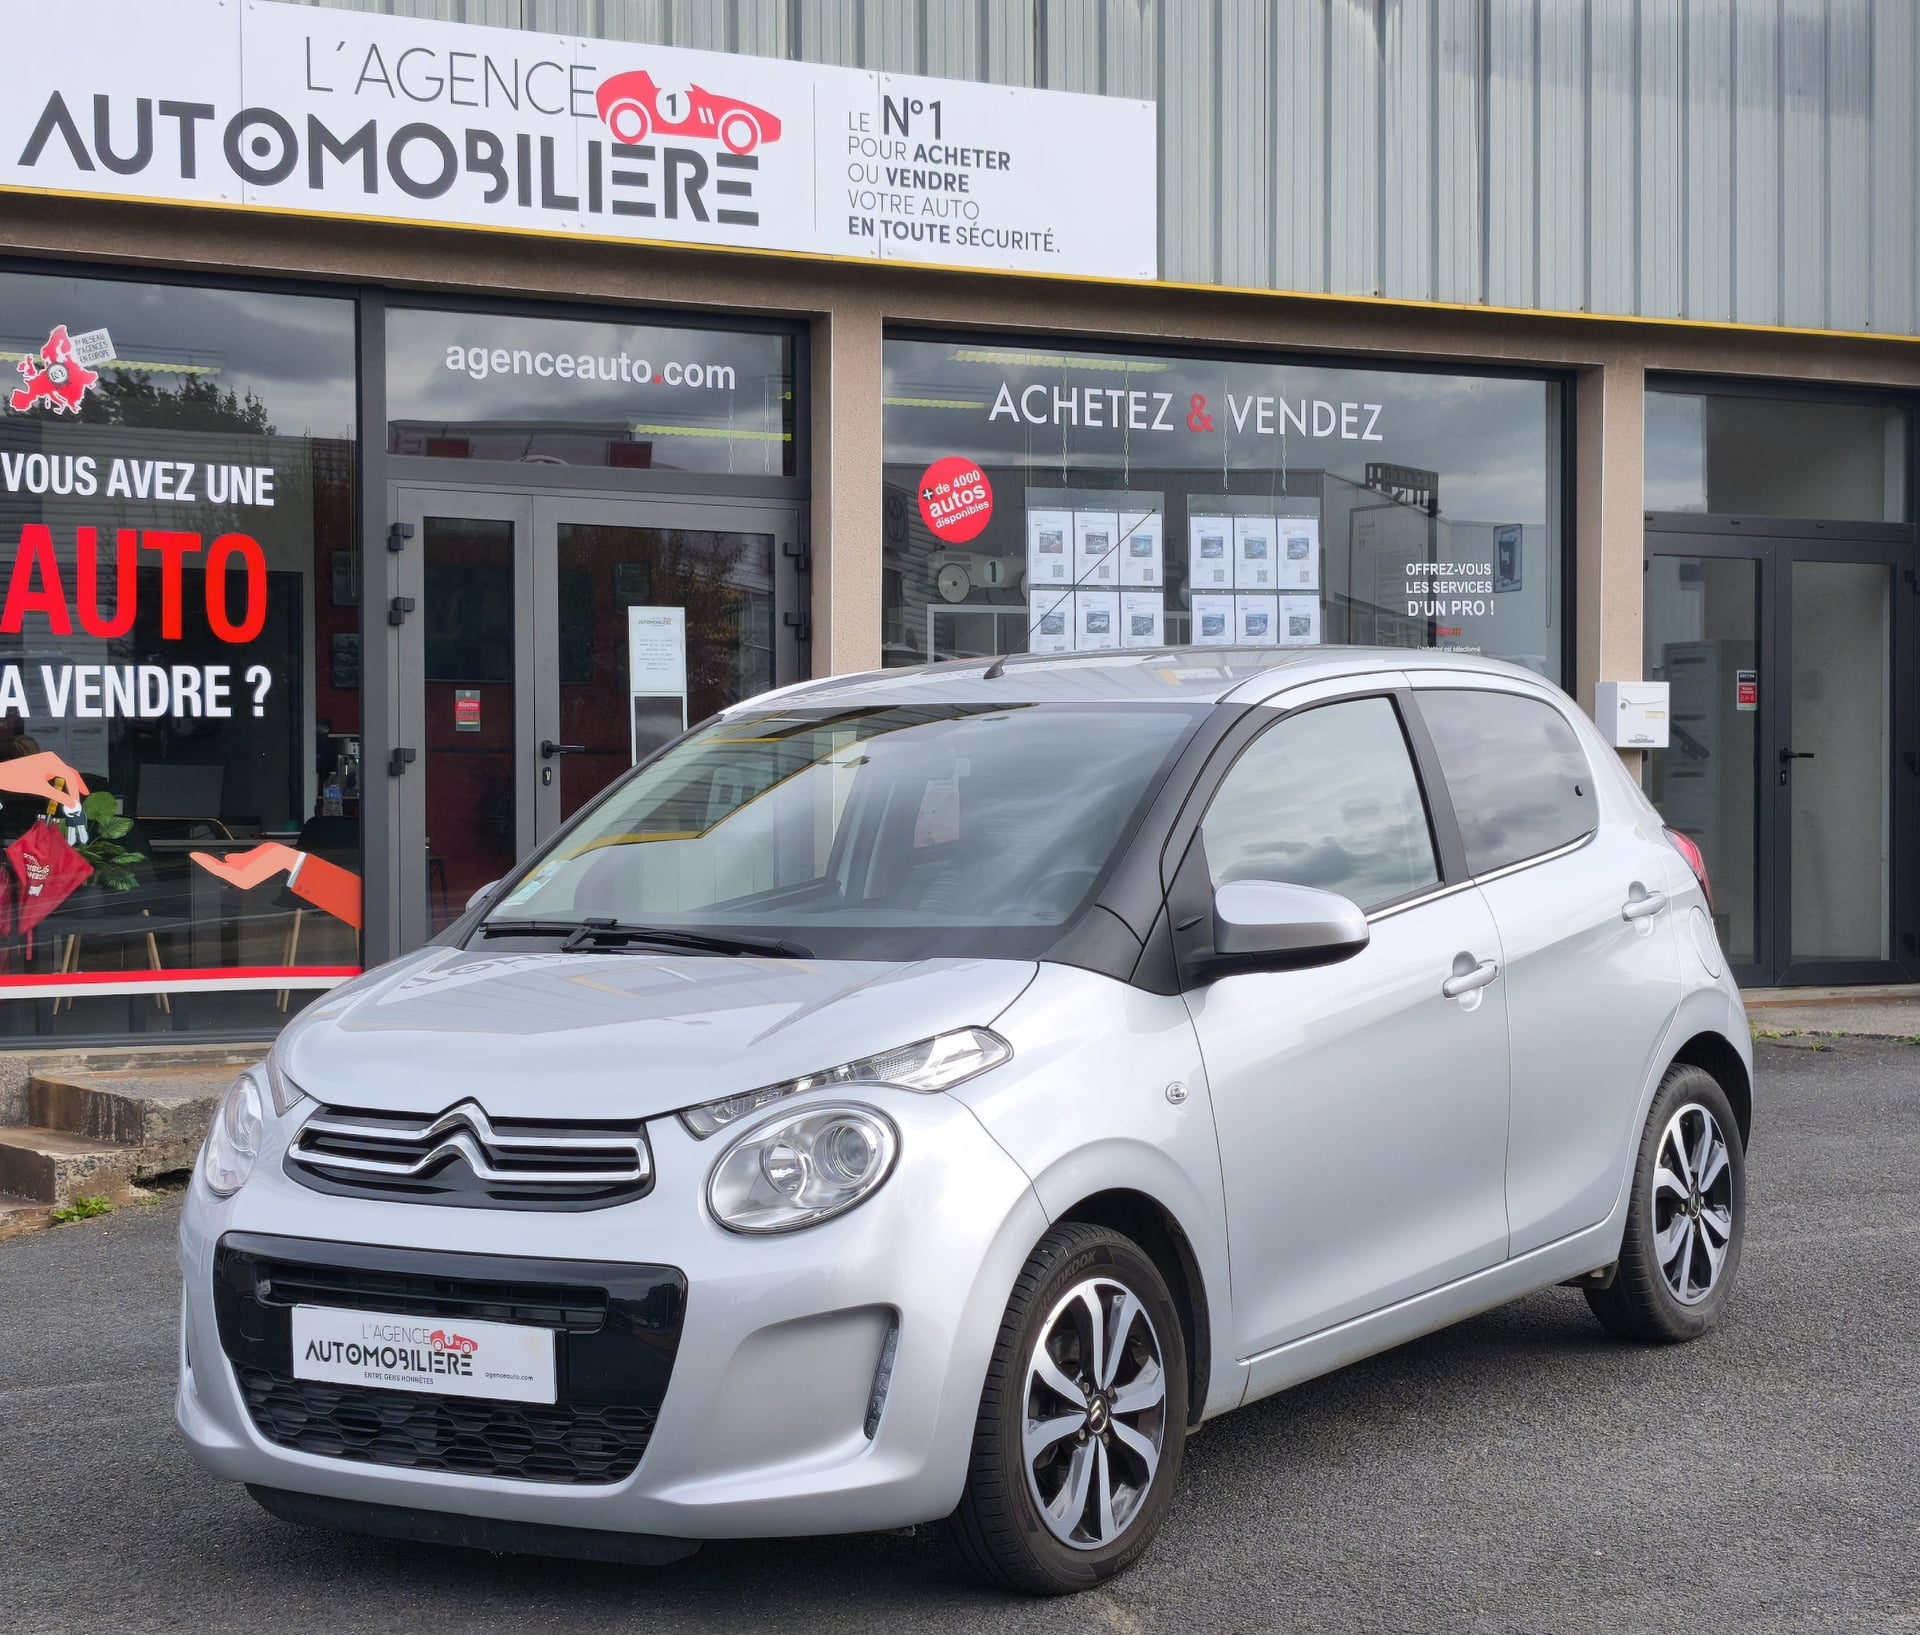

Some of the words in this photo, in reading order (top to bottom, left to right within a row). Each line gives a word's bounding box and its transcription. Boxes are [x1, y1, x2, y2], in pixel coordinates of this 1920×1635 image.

[305, 35, 598, 119] L'AGENCE
[666, 93, 677, 117] 1
[848, 111, 870, 133] LE
[17, 90, 759, 227] AUTOMOBILIERE
[848, 137, 907, 162] POUR
[912, 144, 1011, 171] ACHETER
[848, 162, 879, 186] OU
[885, 167, 970, 193] VENDRE
[848, 188, 915, 216] VOTRE
[920, 194, 979, 221] AUTO
[848, 216, 874, 238] EN
[880, 220, 951, 244] TOUTE
[956, 221, 1060, 254] SÉCURITÉ.
[445, 344, 736, 390] agenceauto.com
[988, 381, 1174, 432] ACHETEZ
[1186, 393, 1215, 433] &
[1227, 392, 1384, 442] VENDEZ
[0, 452, 98, 496] VOUS
[107, 459, 196, 502] AVEZ
[207, 464, 275, 507] UNE
[935, 482, 951, 495] de
[952, 470, 981, 488] 4000
[929, 484, 986, 518] autos
[935, 500, 990, 528] disponibles
[0, 524, 268, 644] AUTO
[989, 561, 997, 582] 1
[1405, 563, 1492, 576] OFFREZ-VOUS
[1405, 581, 1429, 594] LES
[1432, 581, 1493, 594] SERVICES
[1407, 600, 1446, 616] D'UN
[1451, 600, 1485, 616] PRO
[1490, 599, 1494, 616] !
[0, 665, 30, 718] A
[41, 665, 232, 718] VENDRE
[246, 665, 272, 718] ?
[362, 1322, 430, 1345] L'AGENCE
[305, 1339, 473, 1376] AUTOMOBILIERE
[364, 1371, 382, 1381] ENTRE
[383, 1373, 401, 1383] GENS
[401, 1374, 434, 1385] HONNÊTES
[485, 1371, 534, 1382] agenceauto.com
